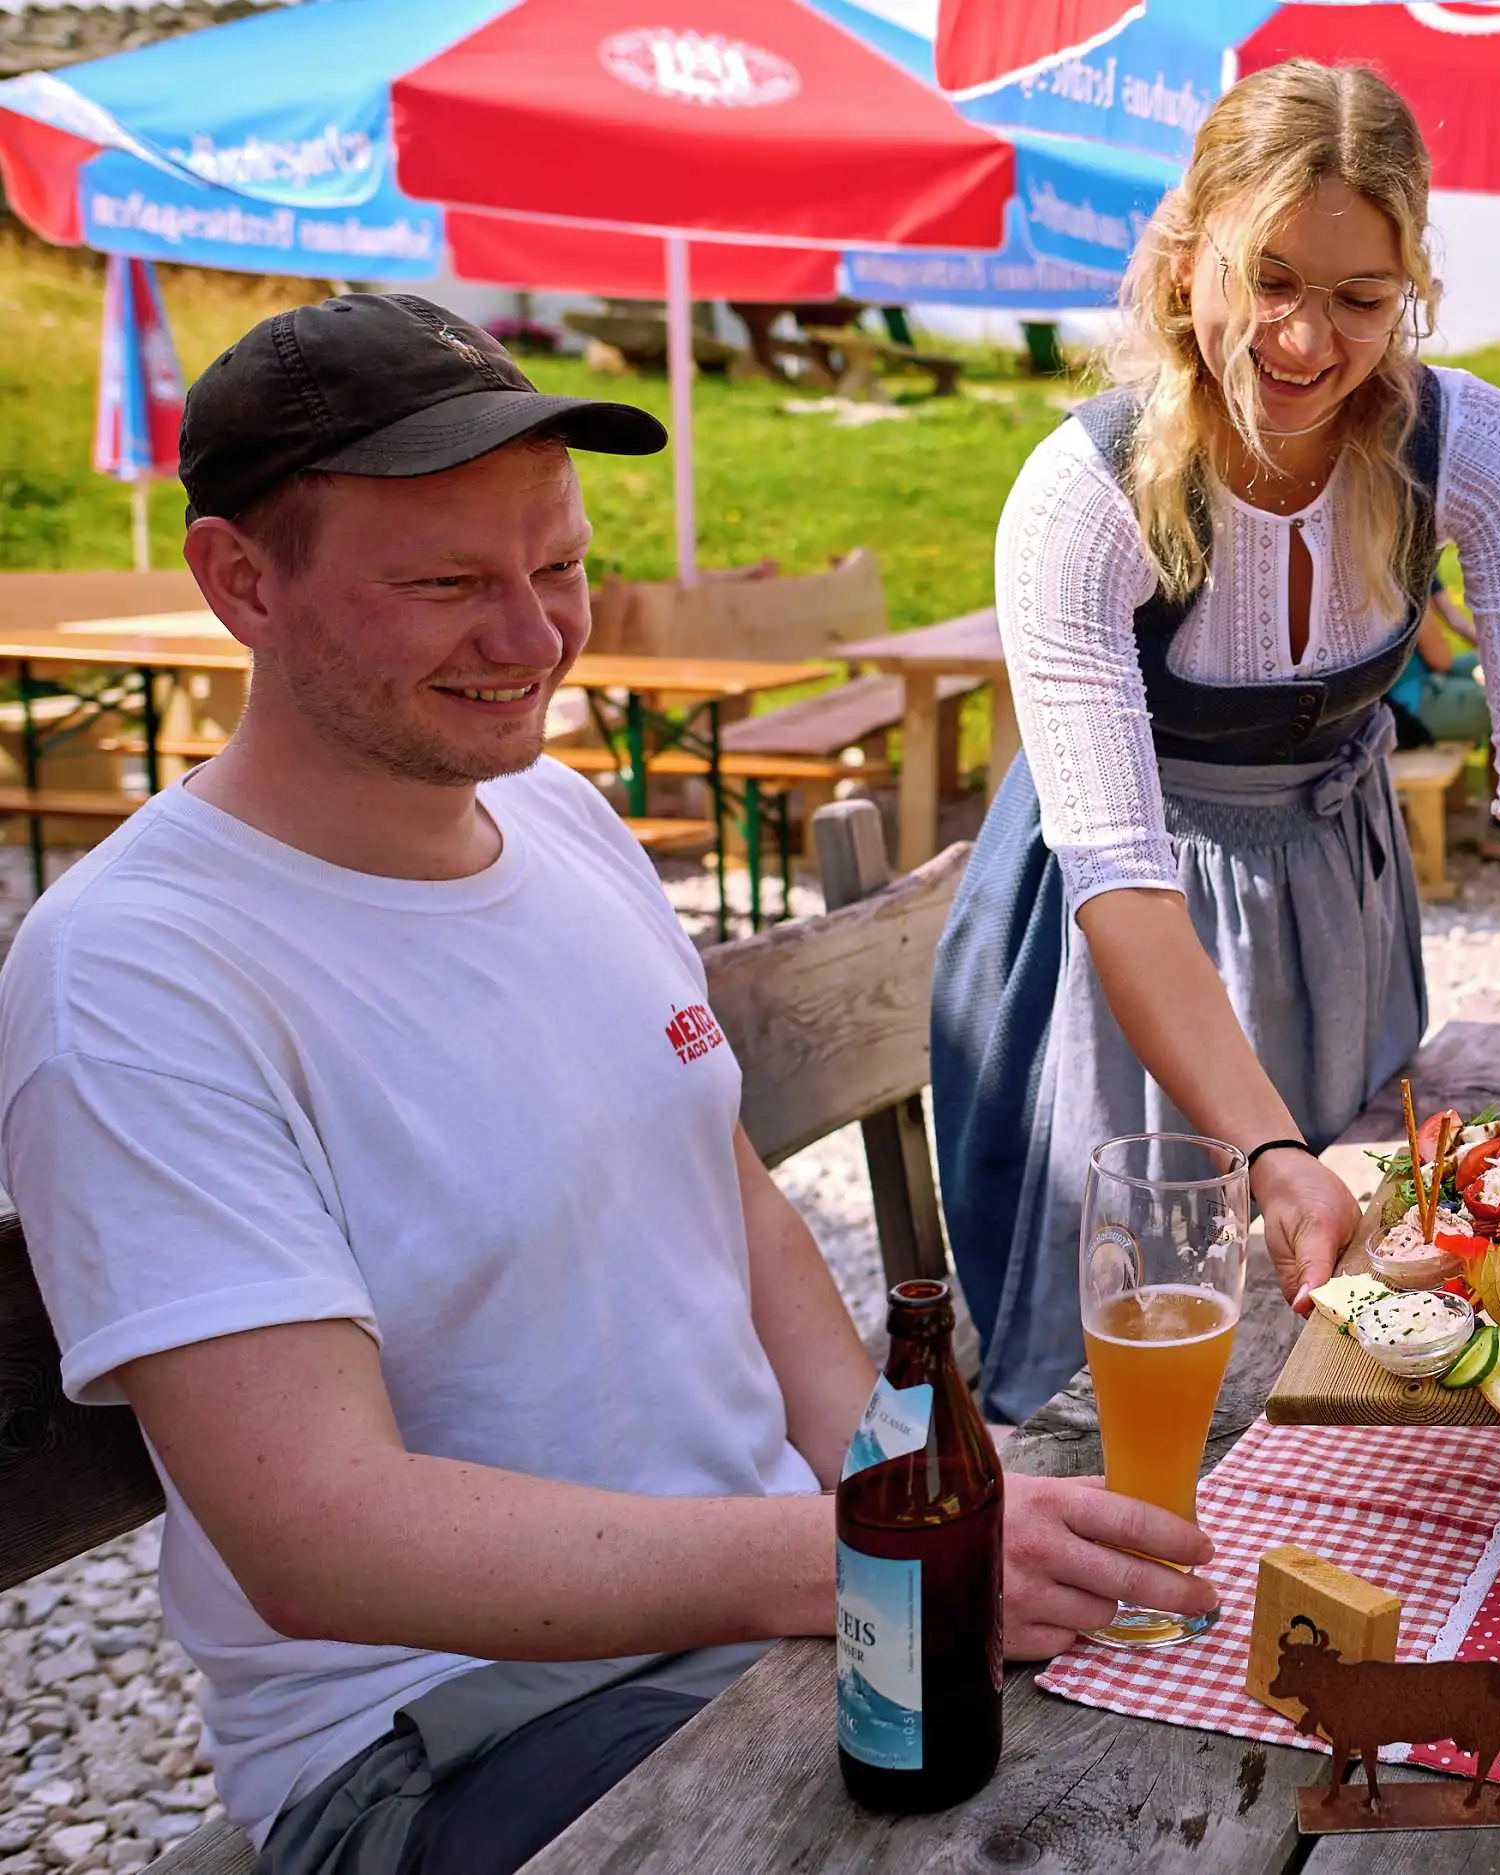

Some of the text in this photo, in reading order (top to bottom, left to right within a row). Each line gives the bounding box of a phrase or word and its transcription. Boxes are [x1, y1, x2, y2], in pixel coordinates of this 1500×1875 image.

[676, 1039, 708, 1065] TACO
[879, 1411, 913, 1437] CLASSIC
[836, 1601, 876, 1647] UEIS
